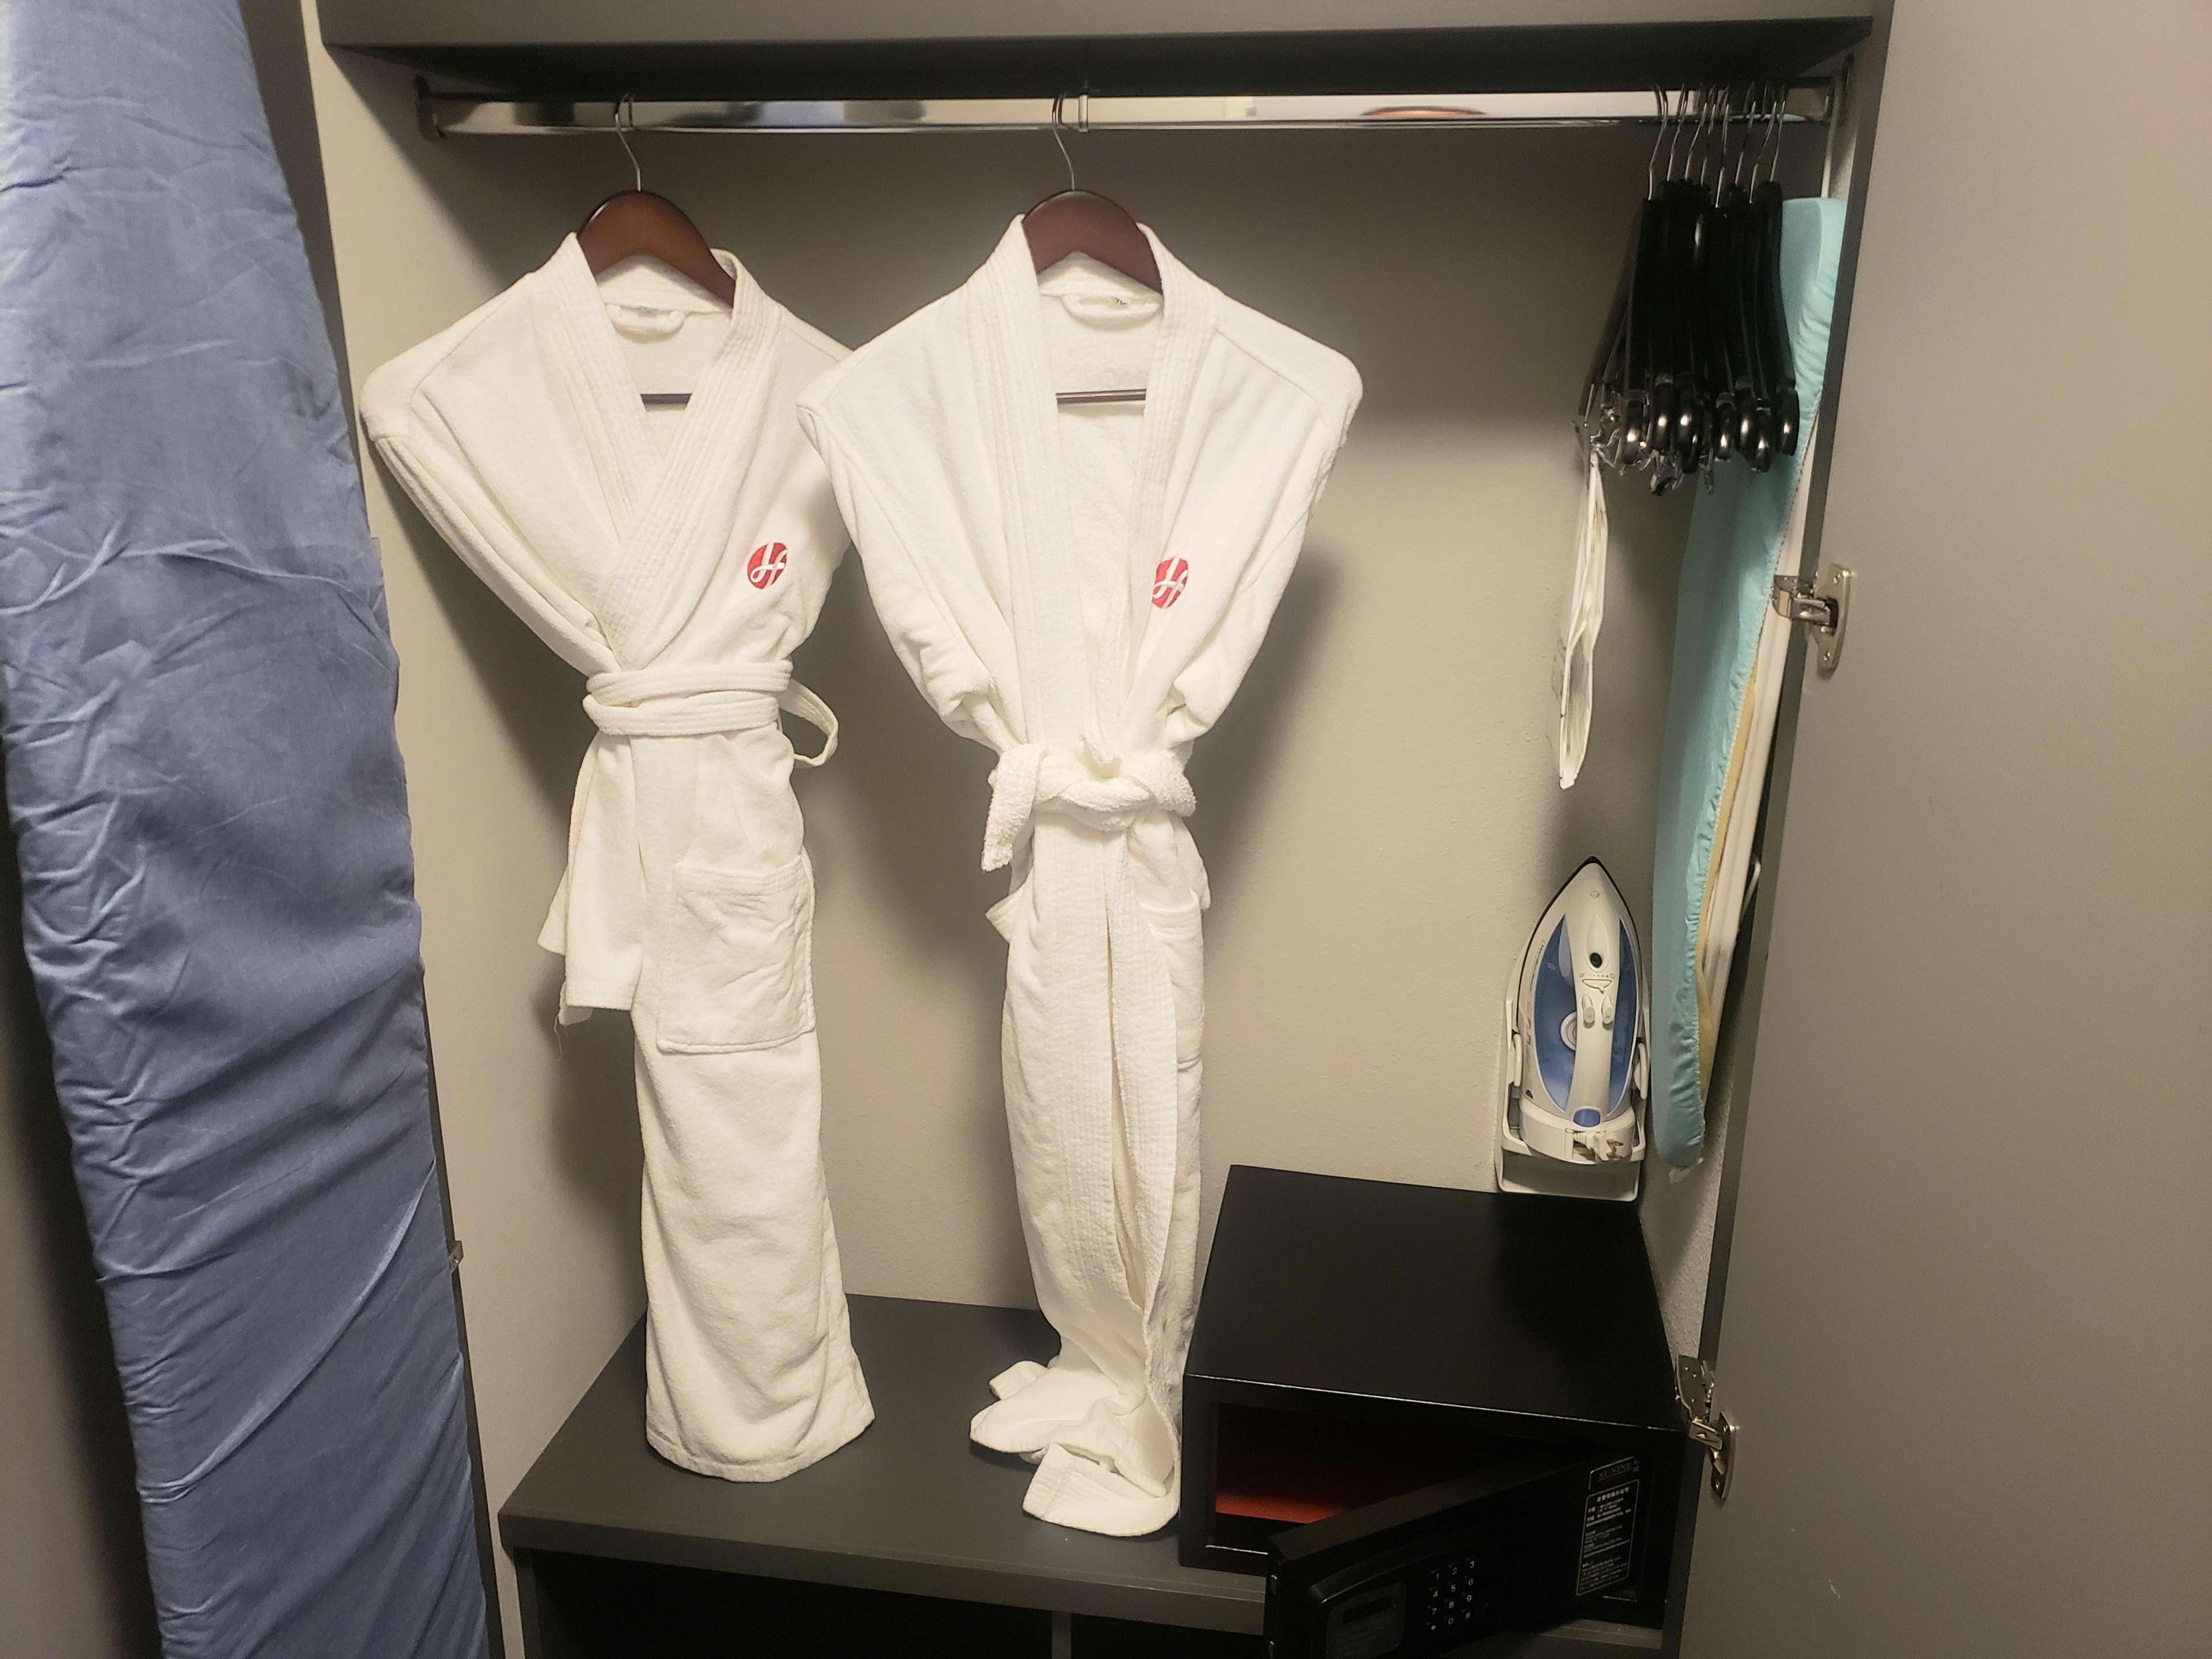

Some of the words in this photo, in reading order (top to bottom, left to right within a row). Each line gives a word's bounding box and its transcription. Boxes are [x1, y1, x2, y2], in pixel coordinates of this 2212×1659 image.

[1452, 1567, 1457, 1575] 2
[1469, 1560, 1475, 1569] 3
[1450, 1584, 1456, 1592] 5
[1468, 1578, 1474, 1586] 6
[1431, 1607, 1437, 1615] 7
[1449, 1601, 1455, 1609] 8
[1466, 1594, 1472, 1603] 9
[1448, 1617, 1454, 1625] 0
